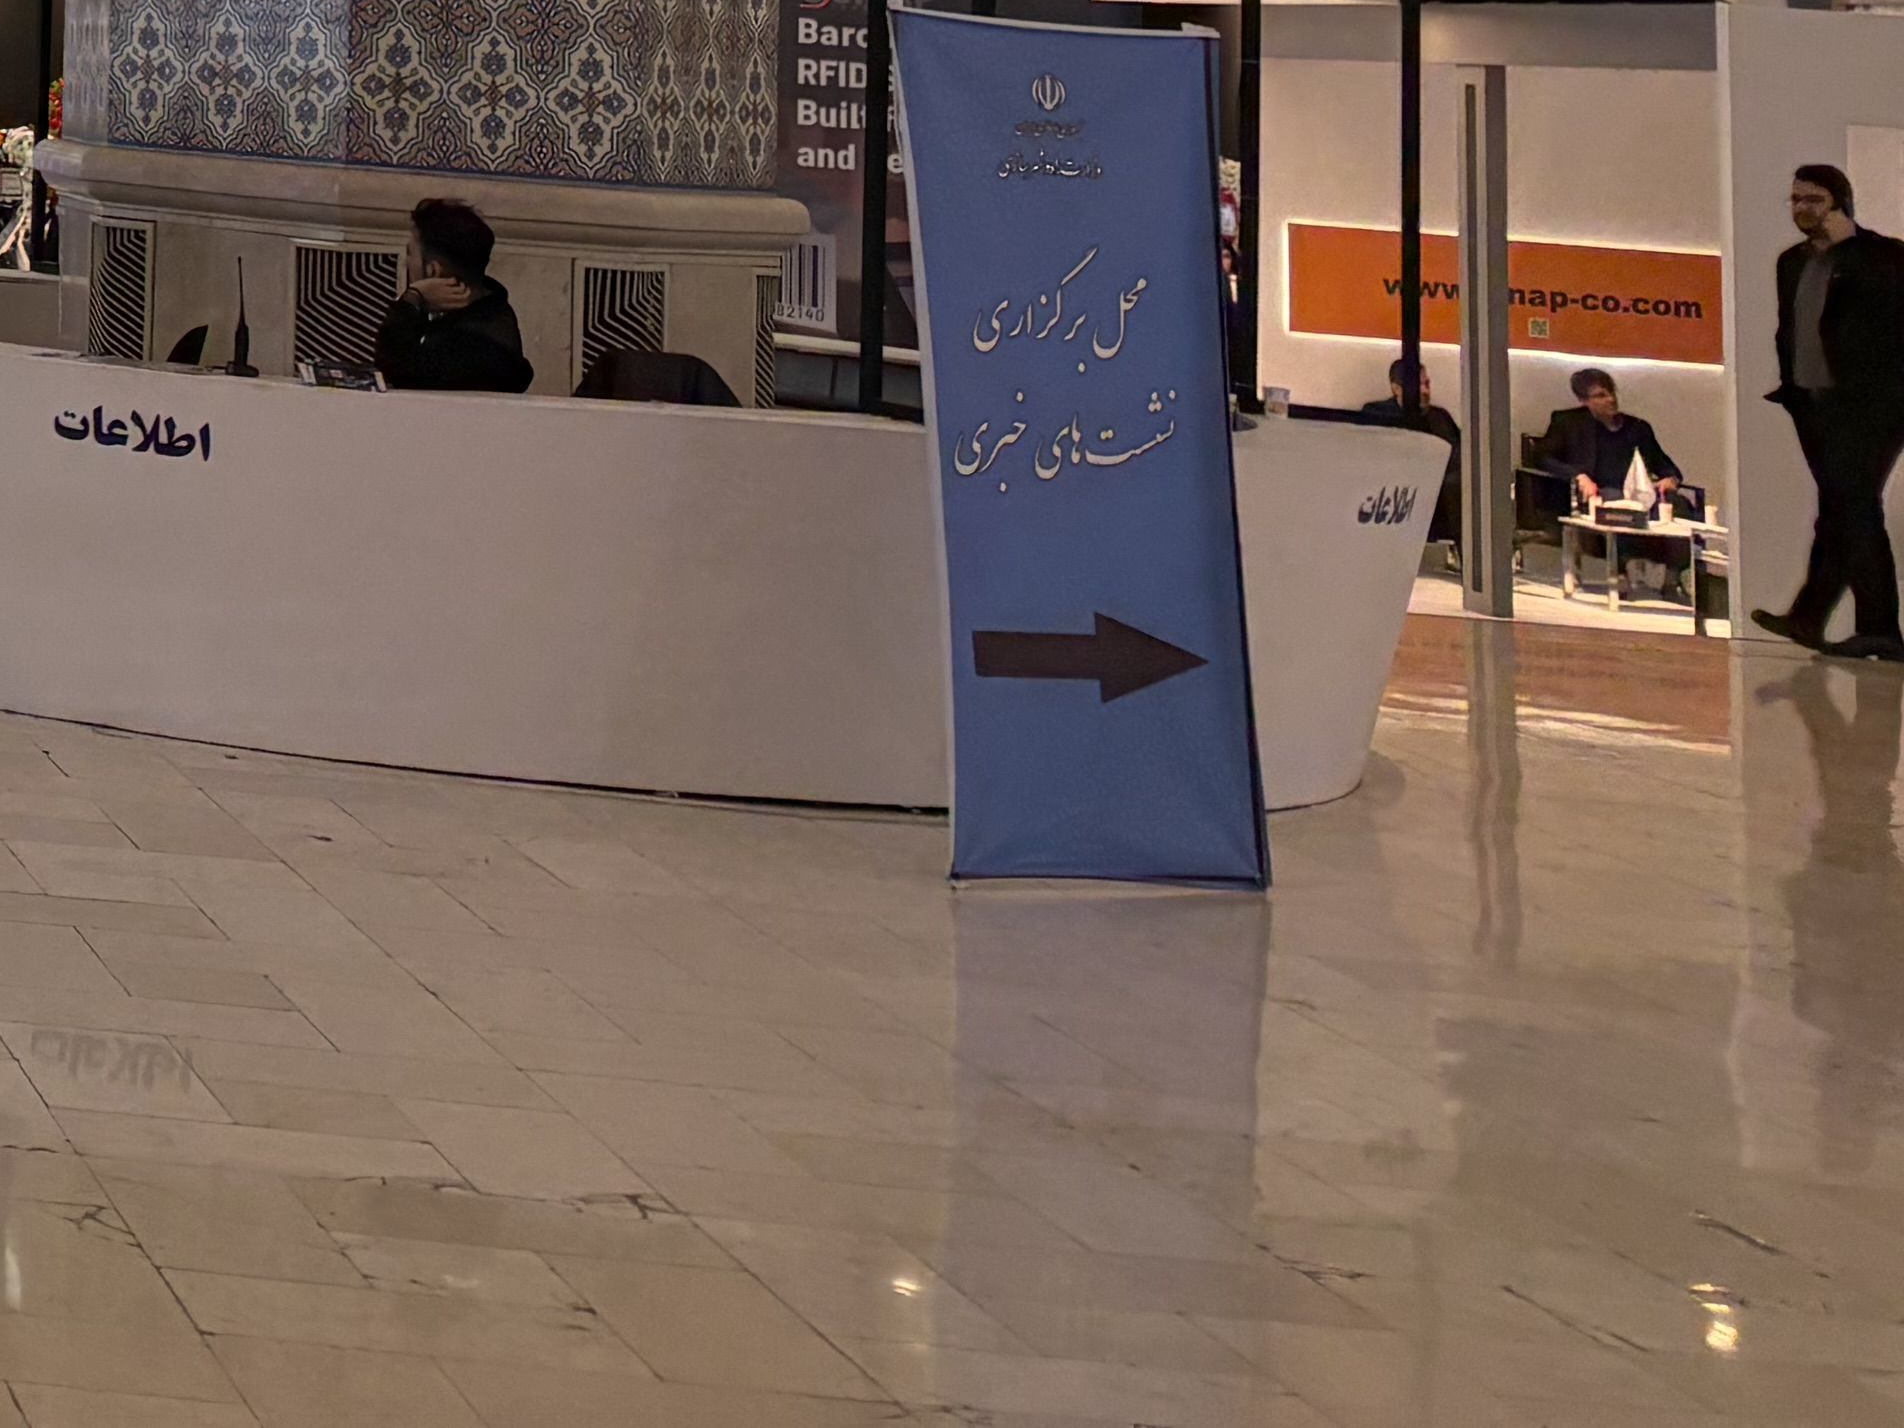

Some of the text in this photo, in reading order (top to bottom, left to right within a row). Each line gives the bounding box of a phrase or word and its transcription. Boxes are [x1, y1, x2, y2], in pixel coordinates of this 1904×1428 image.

[797, 144, 856, 171] and
[1093, 276, 1149, 359] محل
[53, 404, 211, 462] اطلاعات
[954, 390, 1177, 493] نشست های خبری
